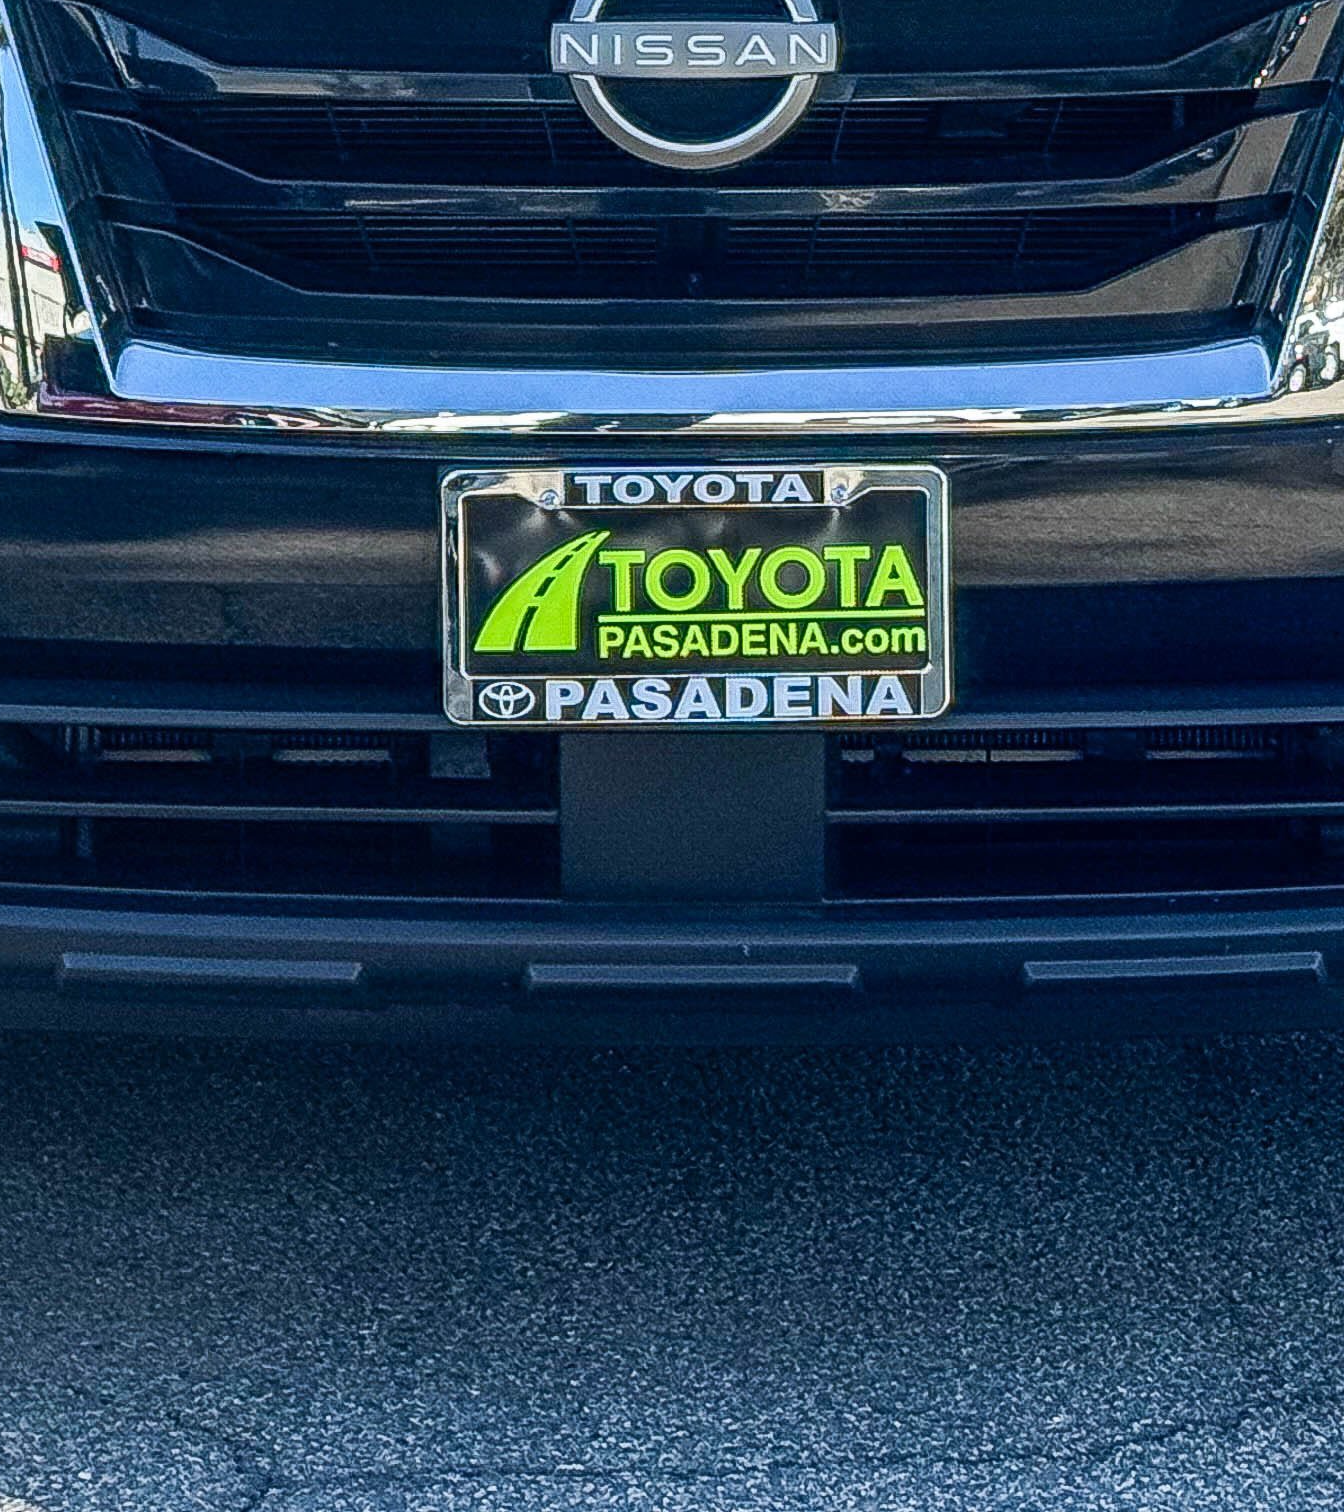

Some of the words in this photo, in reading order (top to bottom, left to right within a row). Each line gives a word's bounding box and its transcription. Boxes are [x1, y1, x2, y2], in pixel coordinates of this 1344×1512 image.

[559, 34, 828, 66] NISSAN
[574, 474, 813, 504] TOYOTA
[598, 545, 925, 611] TOYOTA
[598, 622, 926, 659] PASADENA.com
[545, 676, 913, 719] PASADENA
